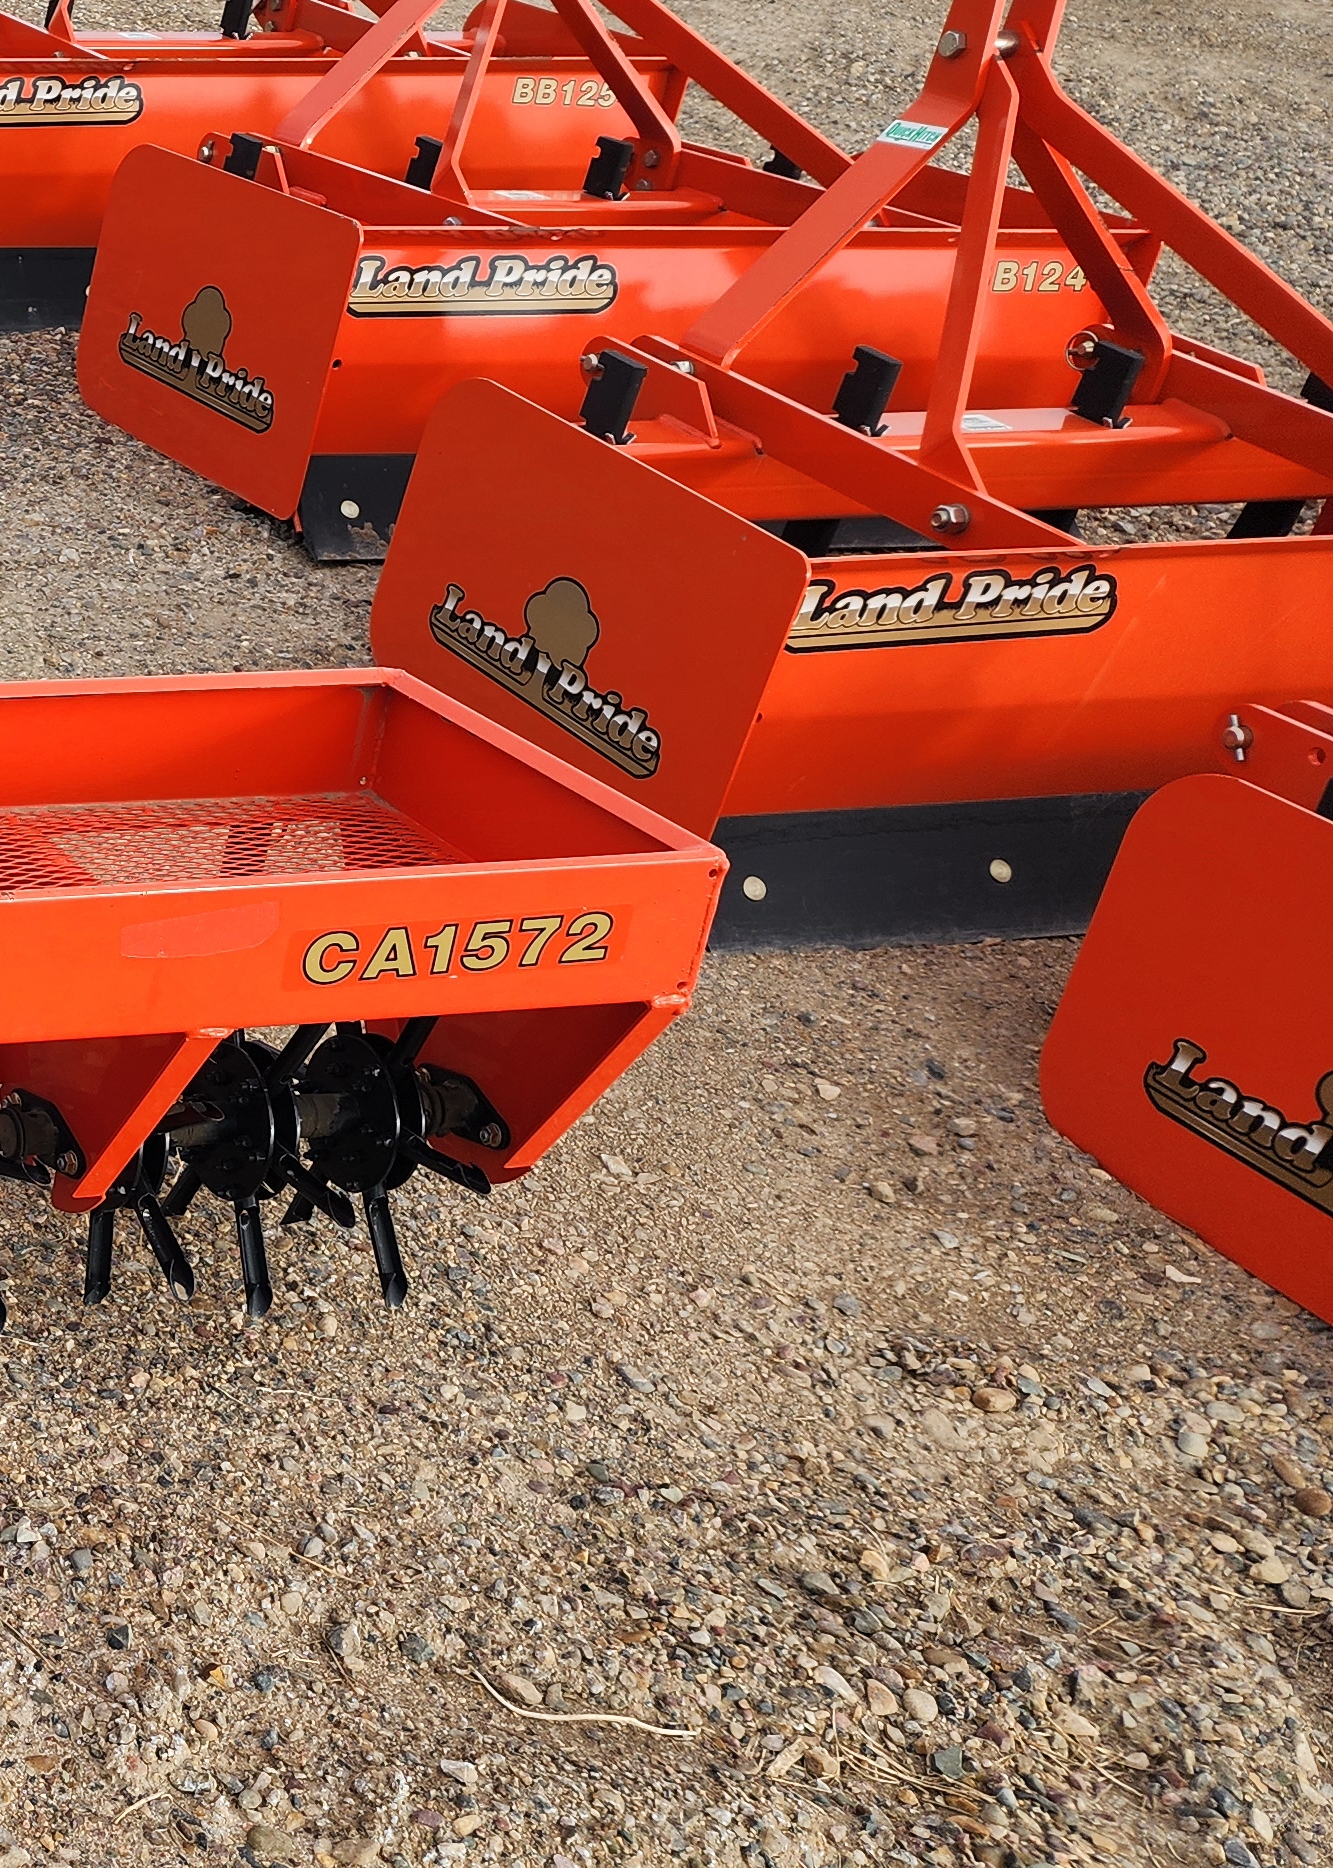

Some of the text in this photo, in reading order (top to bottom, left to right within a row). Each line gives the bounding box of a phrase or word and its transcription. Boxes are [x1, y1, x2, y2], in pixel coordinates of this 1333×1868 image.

[29, 78, 139, 111] Pride
[350, 257, 613, 298] Land Pride
[121, 312, 274, 418] Land Pride
[793, 569, 1111, 630] Land Pride
[434, 584, 661, 763] Land Pride
[301, 911, 614, 985] CA1572
[1151, 1040, 1333, 1174] Land
